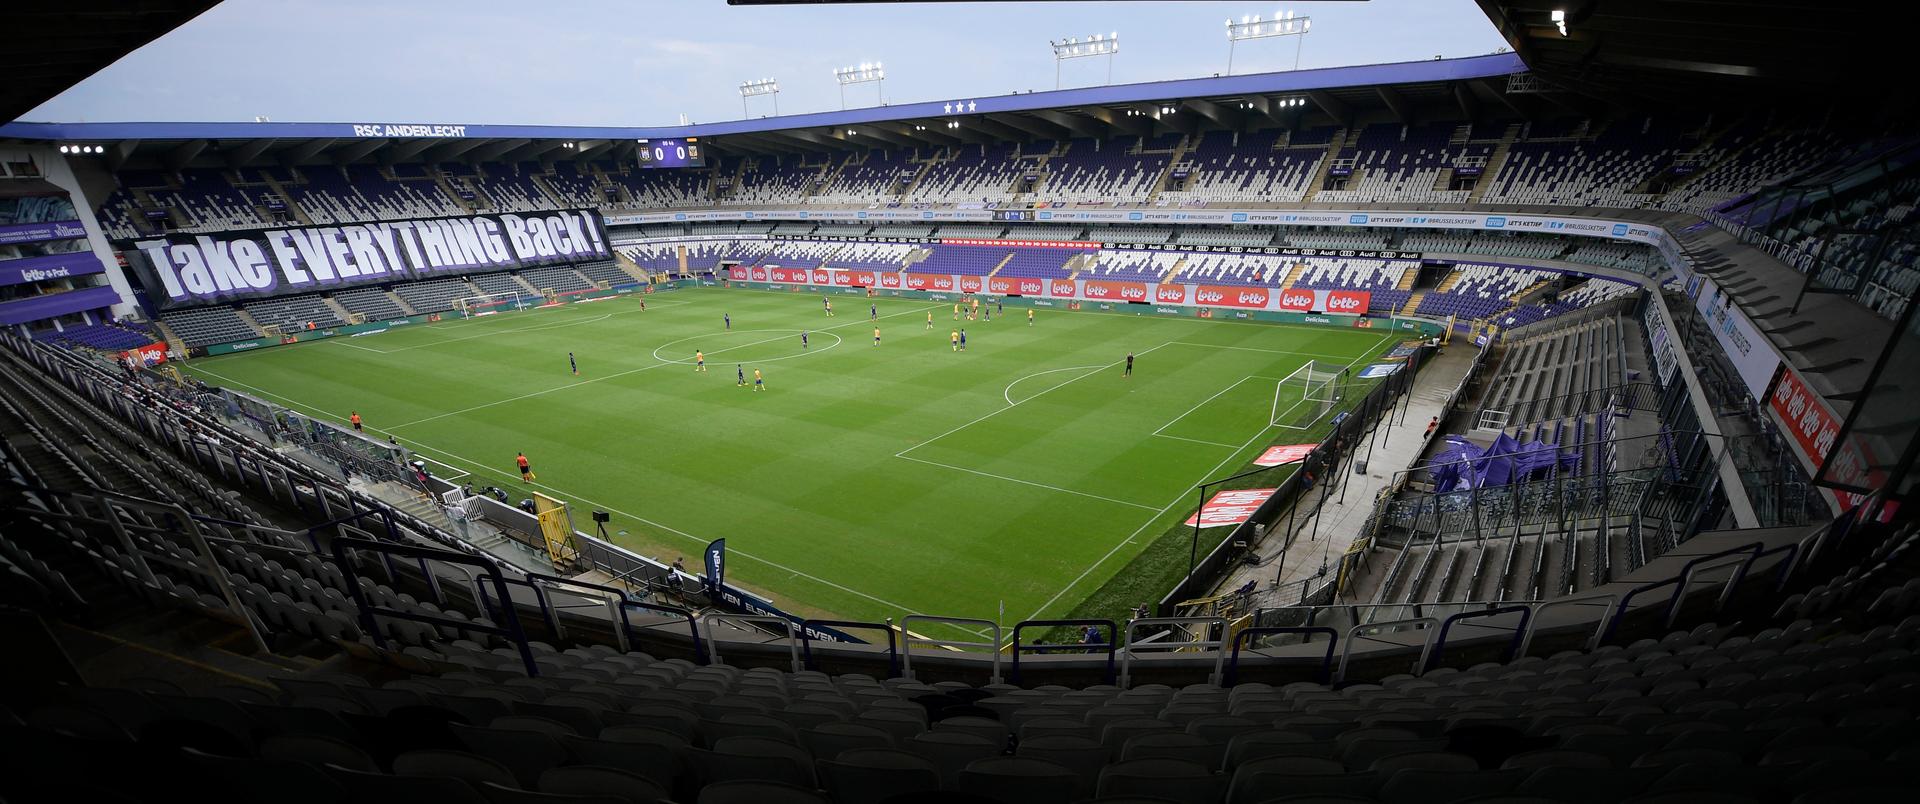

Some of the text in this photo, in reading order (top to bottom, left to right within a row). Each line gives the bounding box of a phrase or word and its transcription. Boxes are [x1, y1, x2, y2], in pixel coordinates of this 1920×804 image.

[353, 125, 466, 138] RSC ANDERLECHT
[655, 147, 664, 161] 0
[676, 146, 685, 160] 0
[54, 224, 86, 237] willems
[136, 210, 605, 298] Take EVERYTHING Back!
[52, 266, 70, 277] Park
[541, 514, 548, 522] 2
[721, 591, 741, 607] VEN
